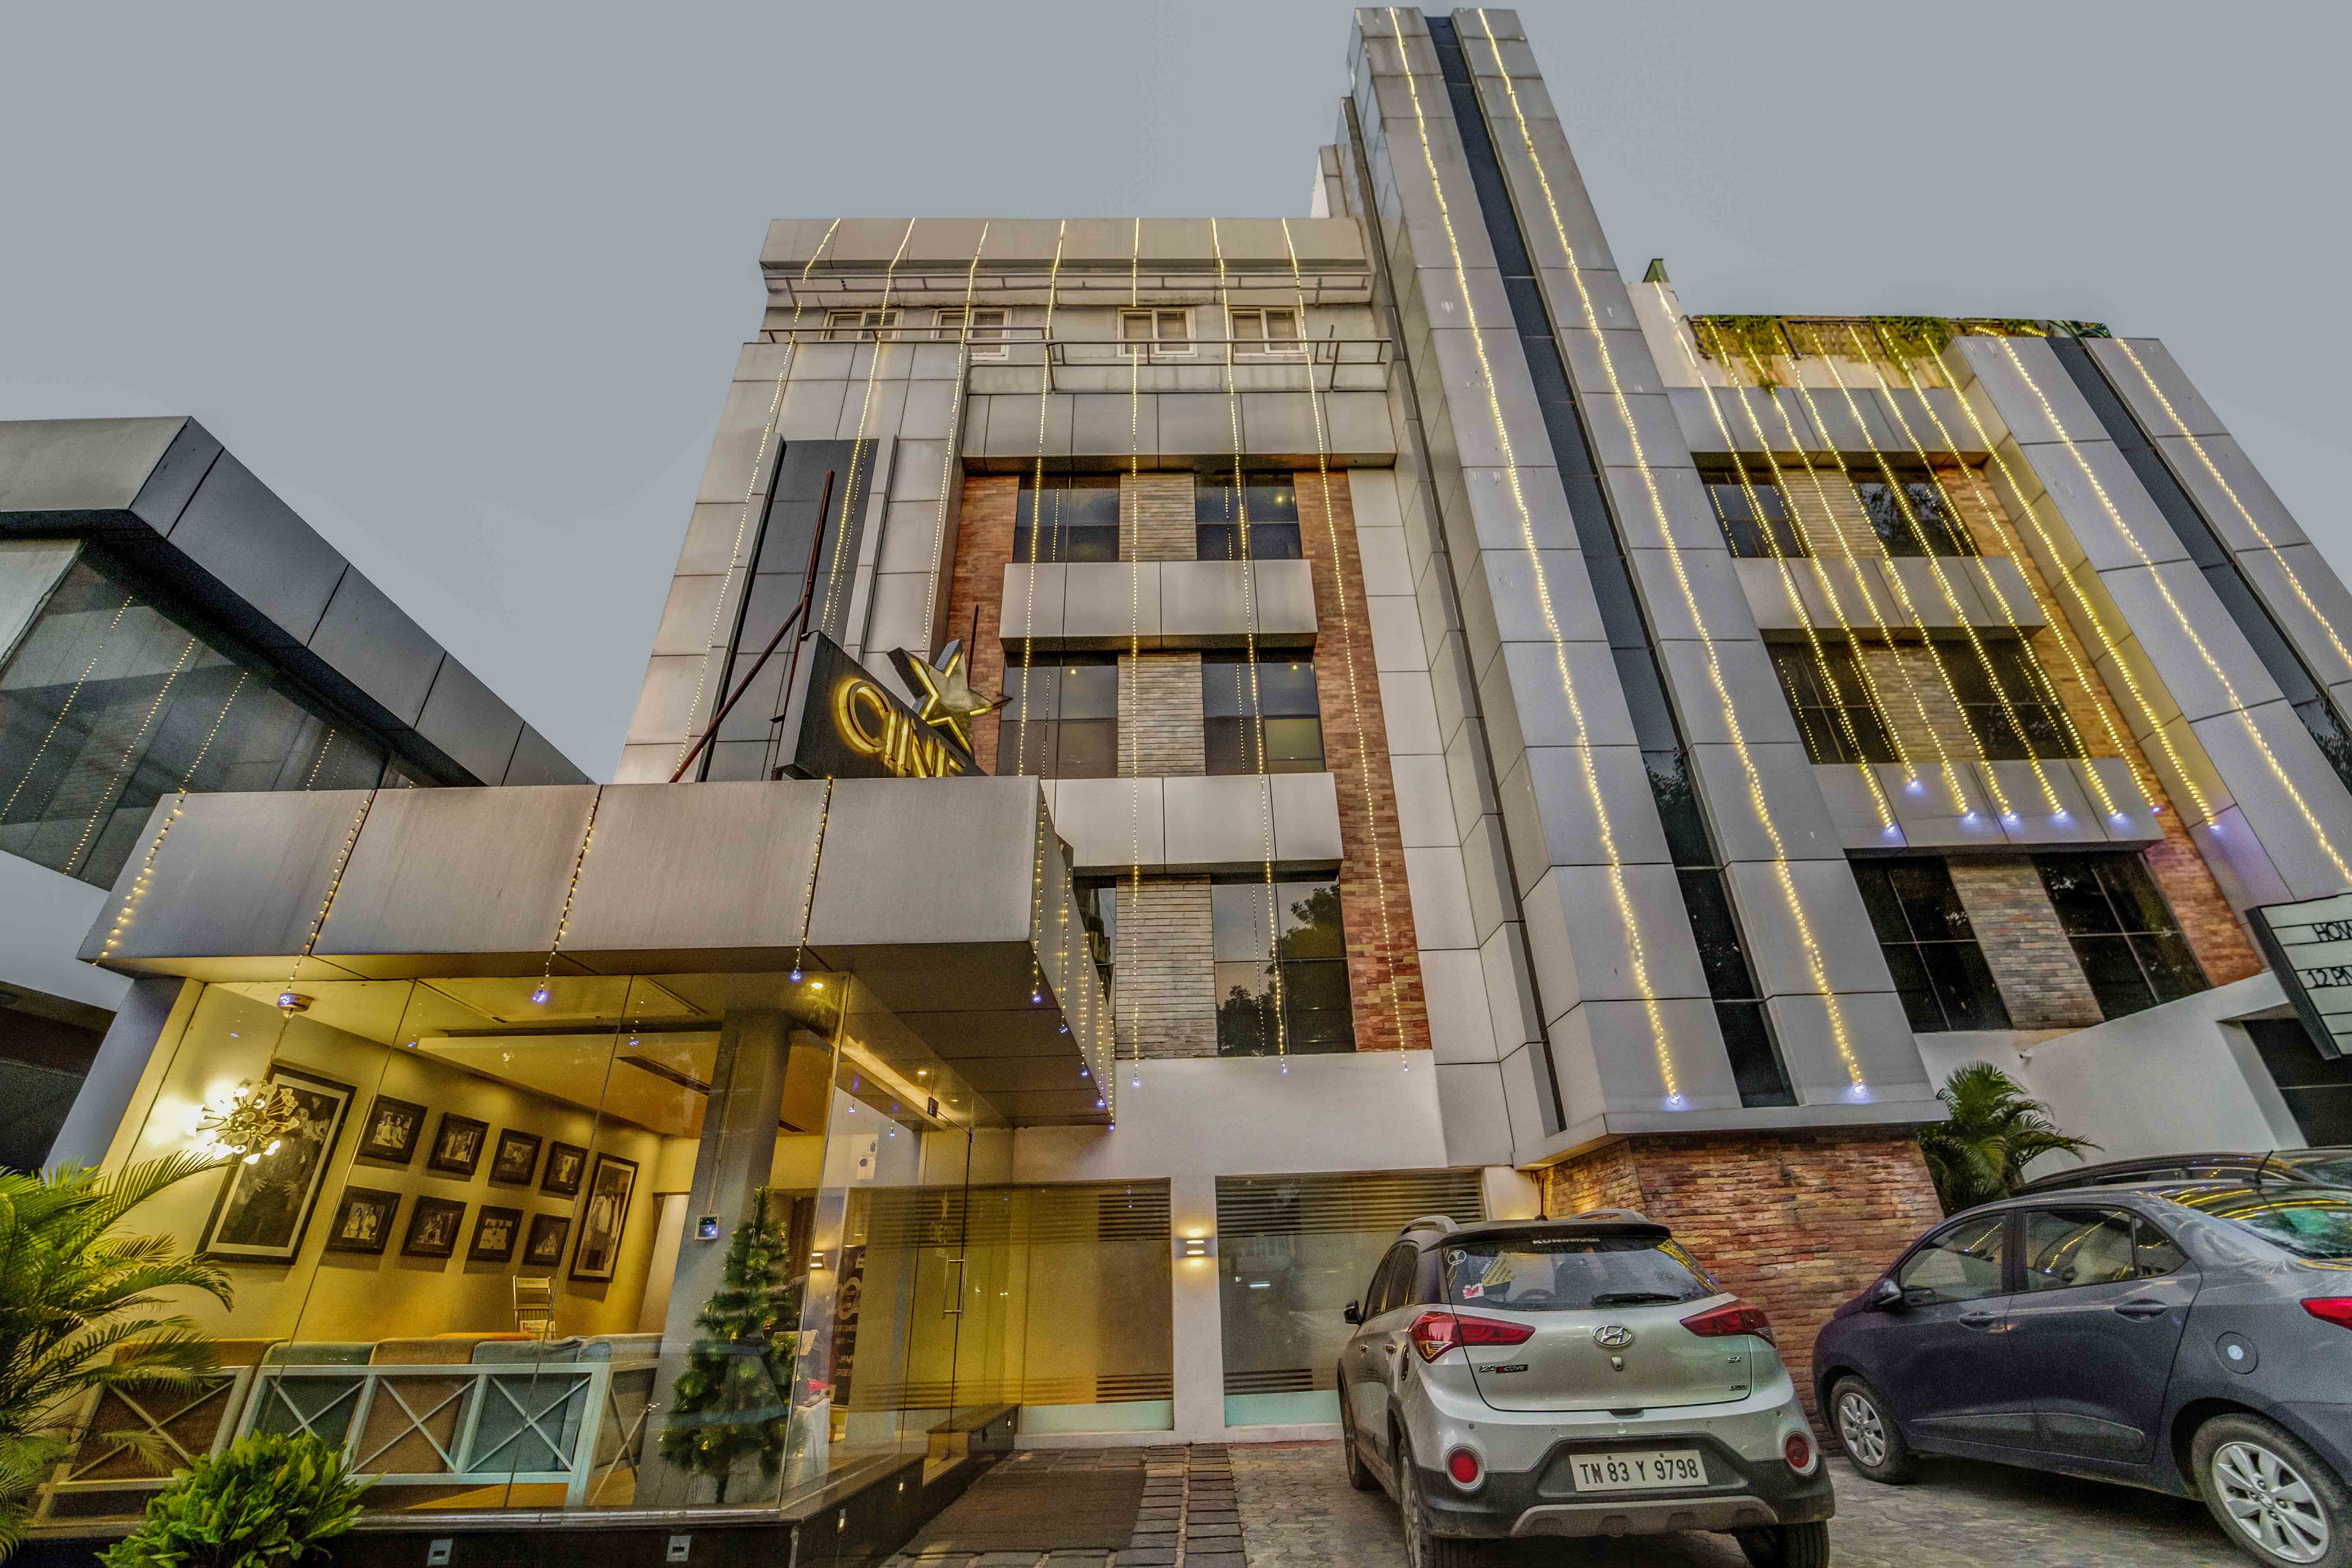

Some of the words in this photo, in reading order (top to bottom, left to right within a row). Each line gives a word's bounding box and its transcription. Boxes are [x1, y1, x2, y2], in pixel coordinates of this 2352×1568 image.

[2306, 968, 2333, 988] 12
[1579, 1463, 1604, 1484] TN
[1607, 1462, 1629, 1482] 83
[1635, 1461, 1645, 1481] Y
[1654, 1458, 1699, 1480] 9798
